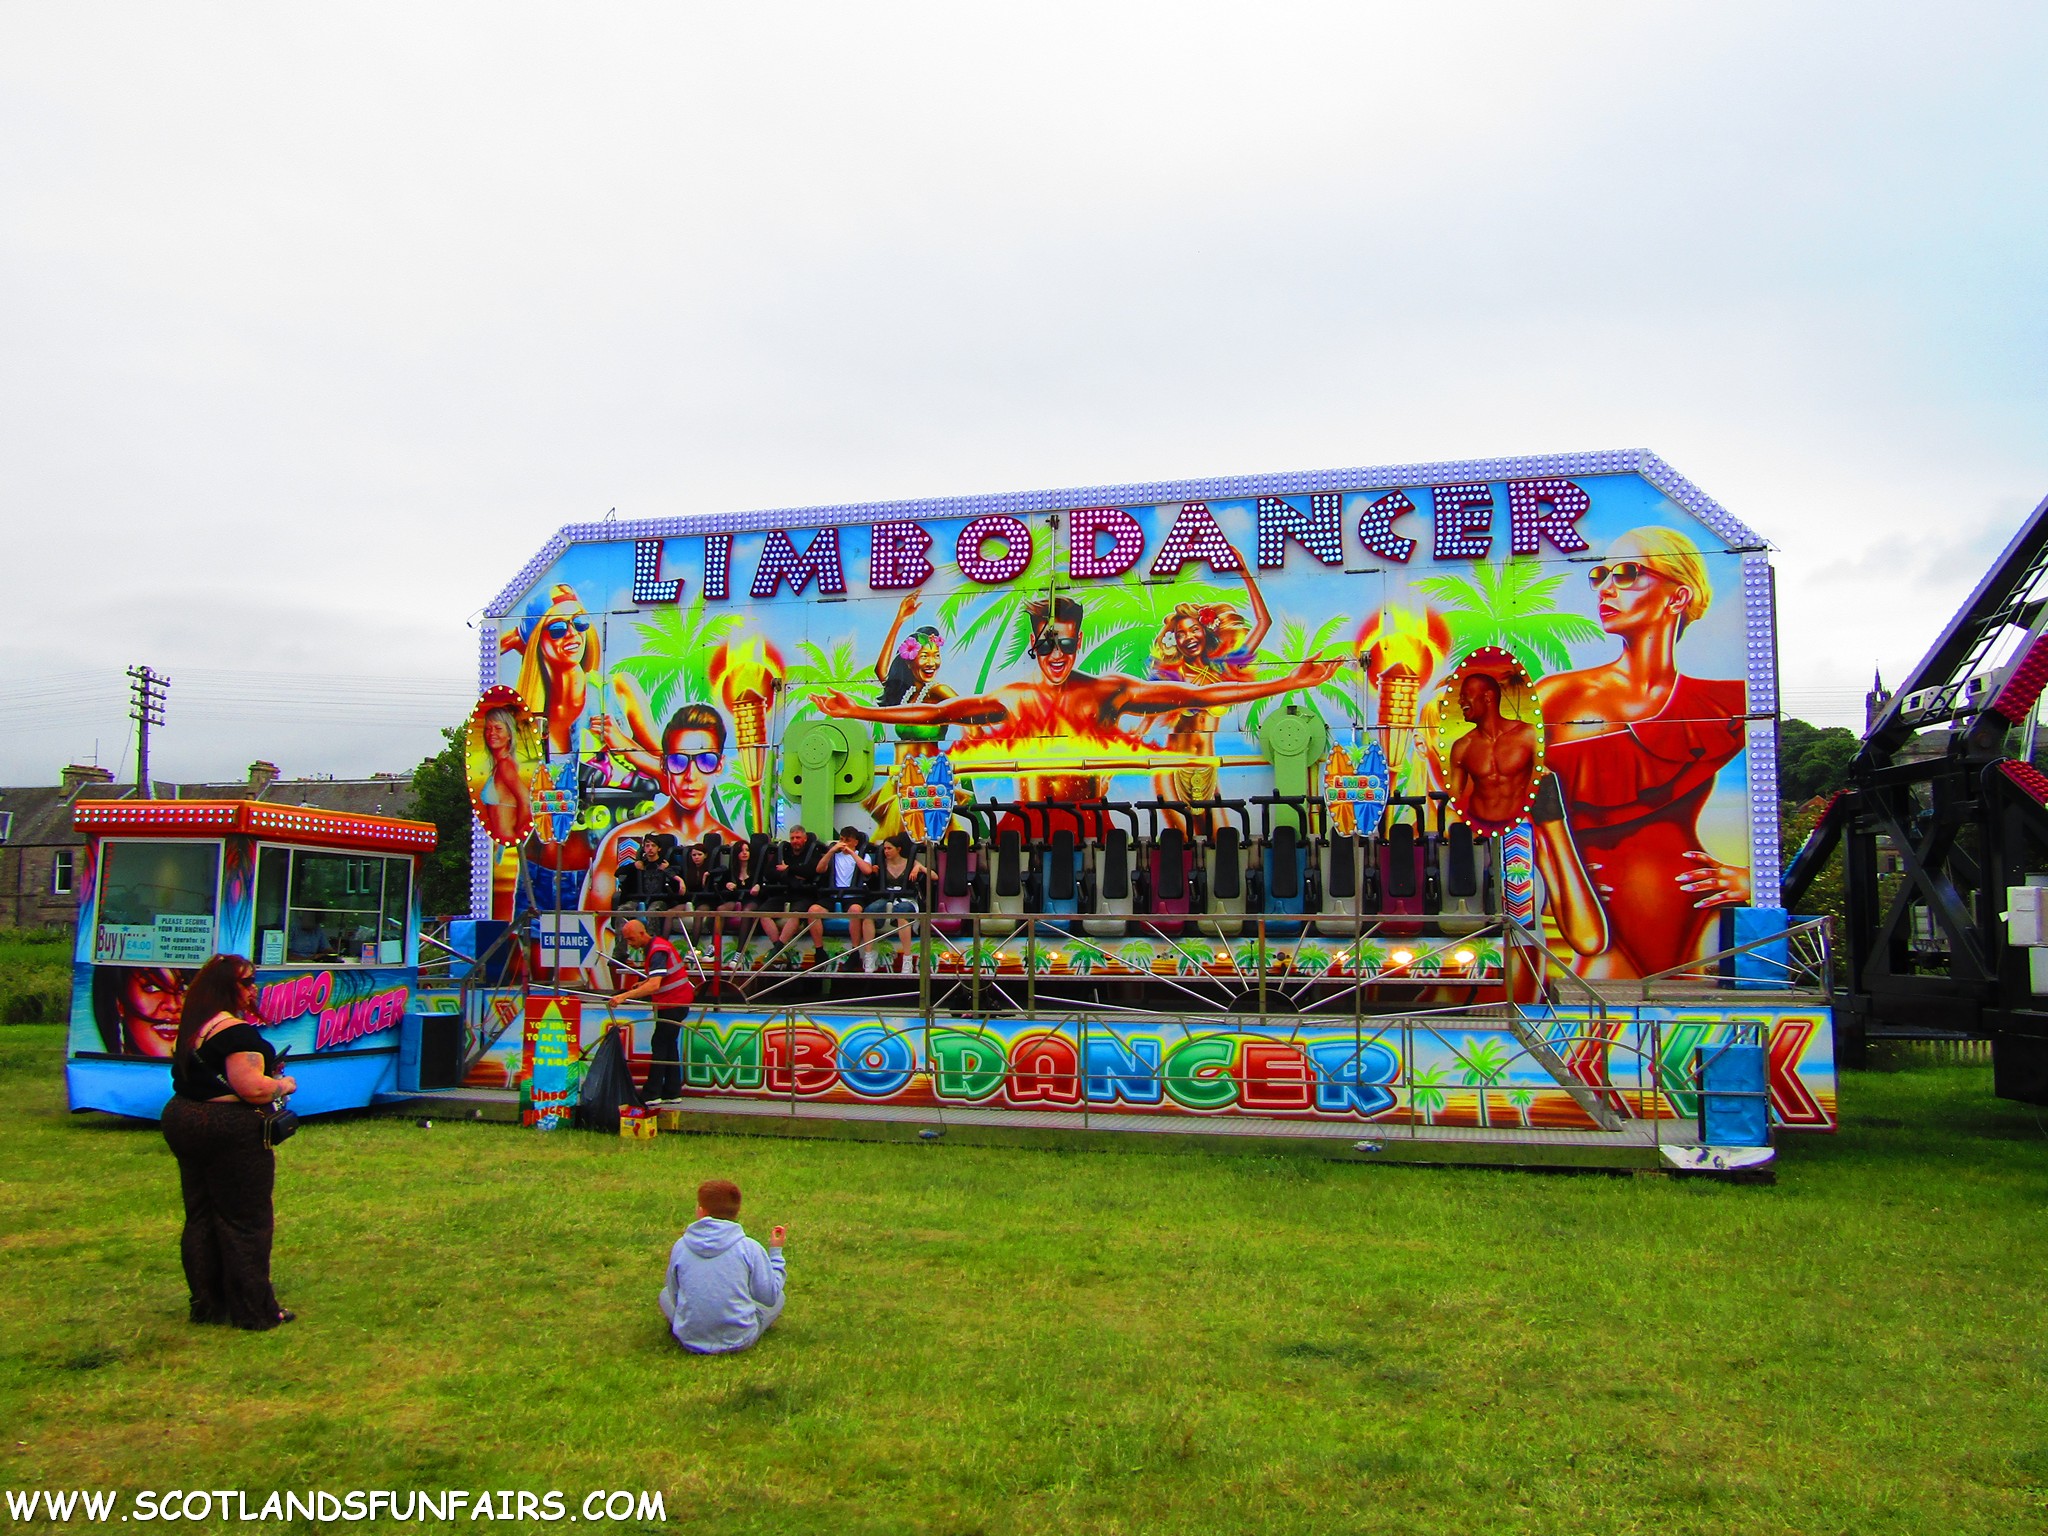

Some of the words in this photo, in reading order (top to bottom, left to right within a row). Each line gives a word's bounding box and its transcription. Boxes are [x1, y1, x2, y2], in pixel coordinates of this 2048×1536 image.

[632, 516, 1033, 604] LIMBO
[1069, 479, 1591, 580] DANCER
[1334, 777, 1379, 788] LIMBO
[908, 786, 946, 797] LIMBO
[1327, 789, 1384, 800] DANCER
[902, 798, 950, 809] DANCER
[544, 935, 589, 947] ENRANCE
[244, 970, 333, 1026] IMBO
[316, 987, 408, 1050] DANCER
[526, 1033, 539, 1041] TO
[532, 1057, 545, 1066] TO
[930, 1032, 1401, 1116] DANCER
[530, 1086, 568, 1102] LIMBO
